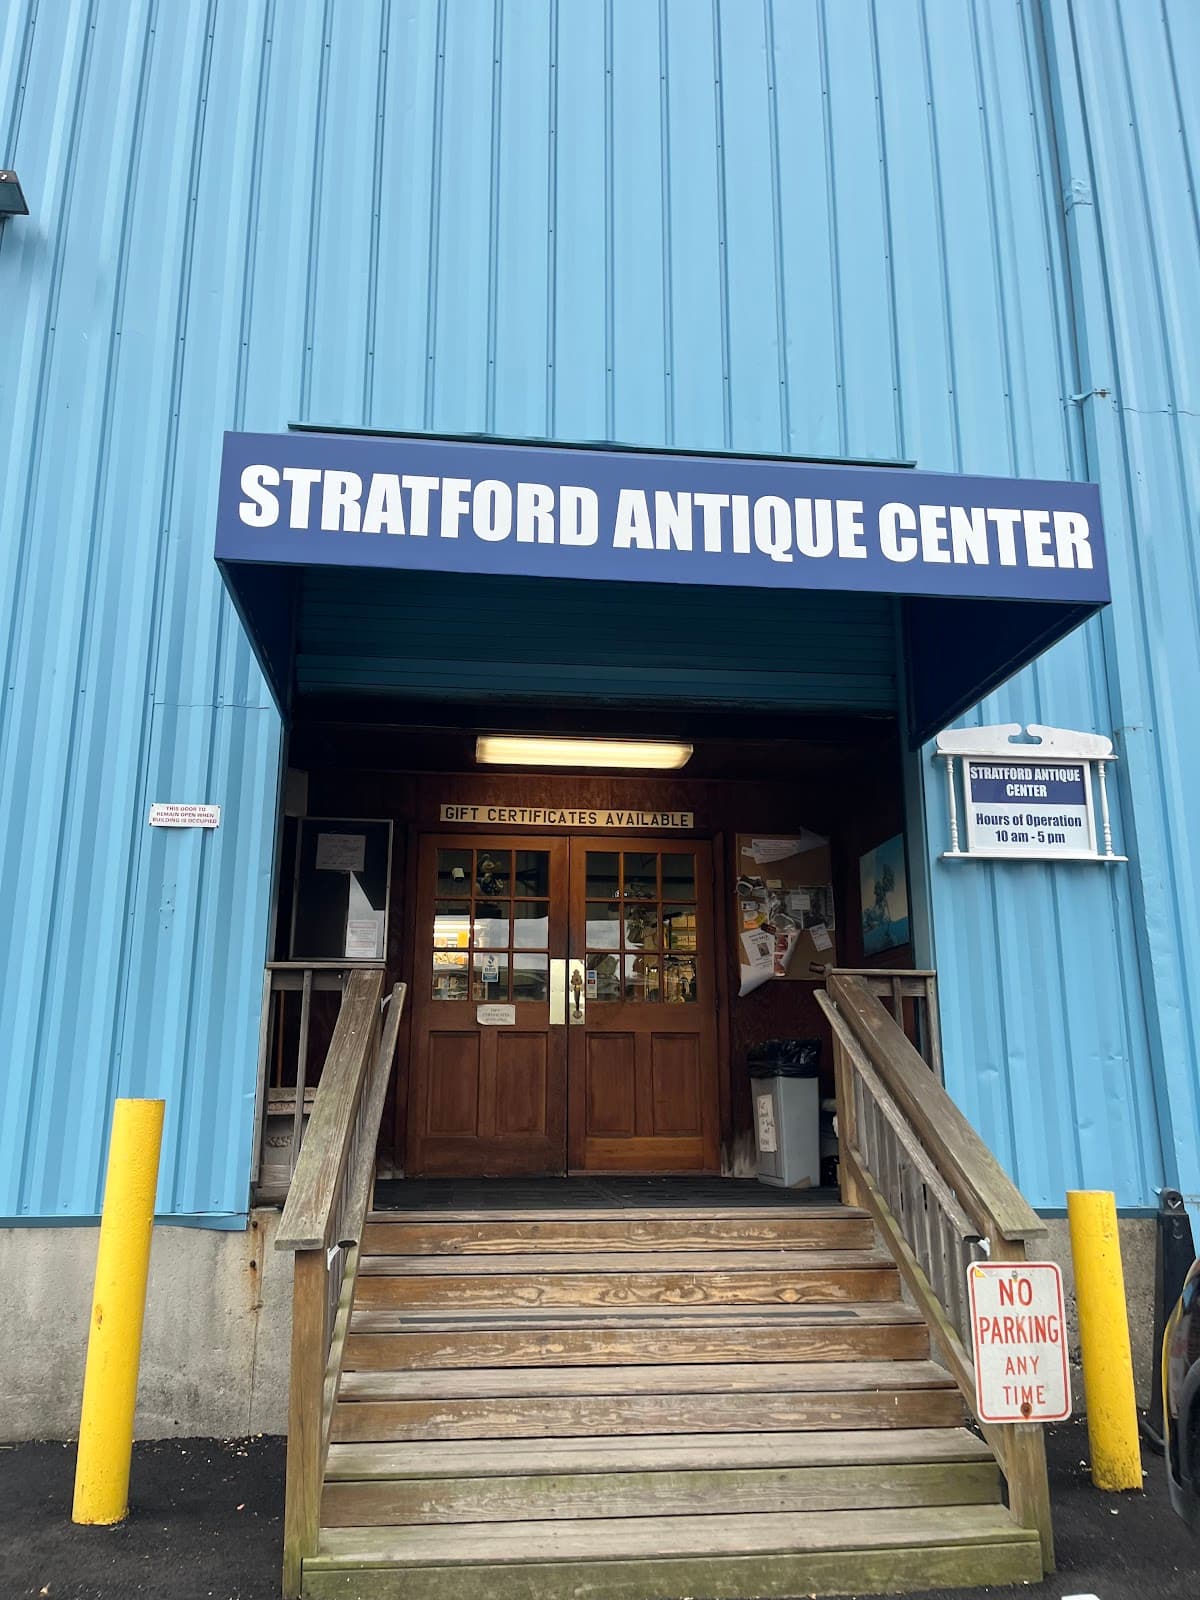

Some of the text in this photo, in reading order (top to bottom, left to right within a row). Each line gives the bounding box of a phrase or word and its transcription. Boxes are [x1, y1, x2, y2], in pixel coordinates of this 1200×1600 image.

[239, 464, 1093, 569] STRATFORD ANTIQUE CENTER
[970, 766, 1081, 782] STRATFORD ANTIQUE
[1006, 783, 1048, 797] CENTER
[445, 806, 689, 827] GIFT CERTIFICATES AVAILABLE
[976, 813, 1082, 827] Hours of Operation
[995, 830, 1009, 842] 10
[1011, 833, 1029, 843] am
[1037, 831, 1045, 843] 5
[1048, 833, 1065, 844] pm
[999, 1278, 1033, 1306] NO
[979, 1315, 1059, 1345] PARKING
[1005, 1356, 1040, 1376] ANY
[1002, 1385, 1046, 1405] TIME
